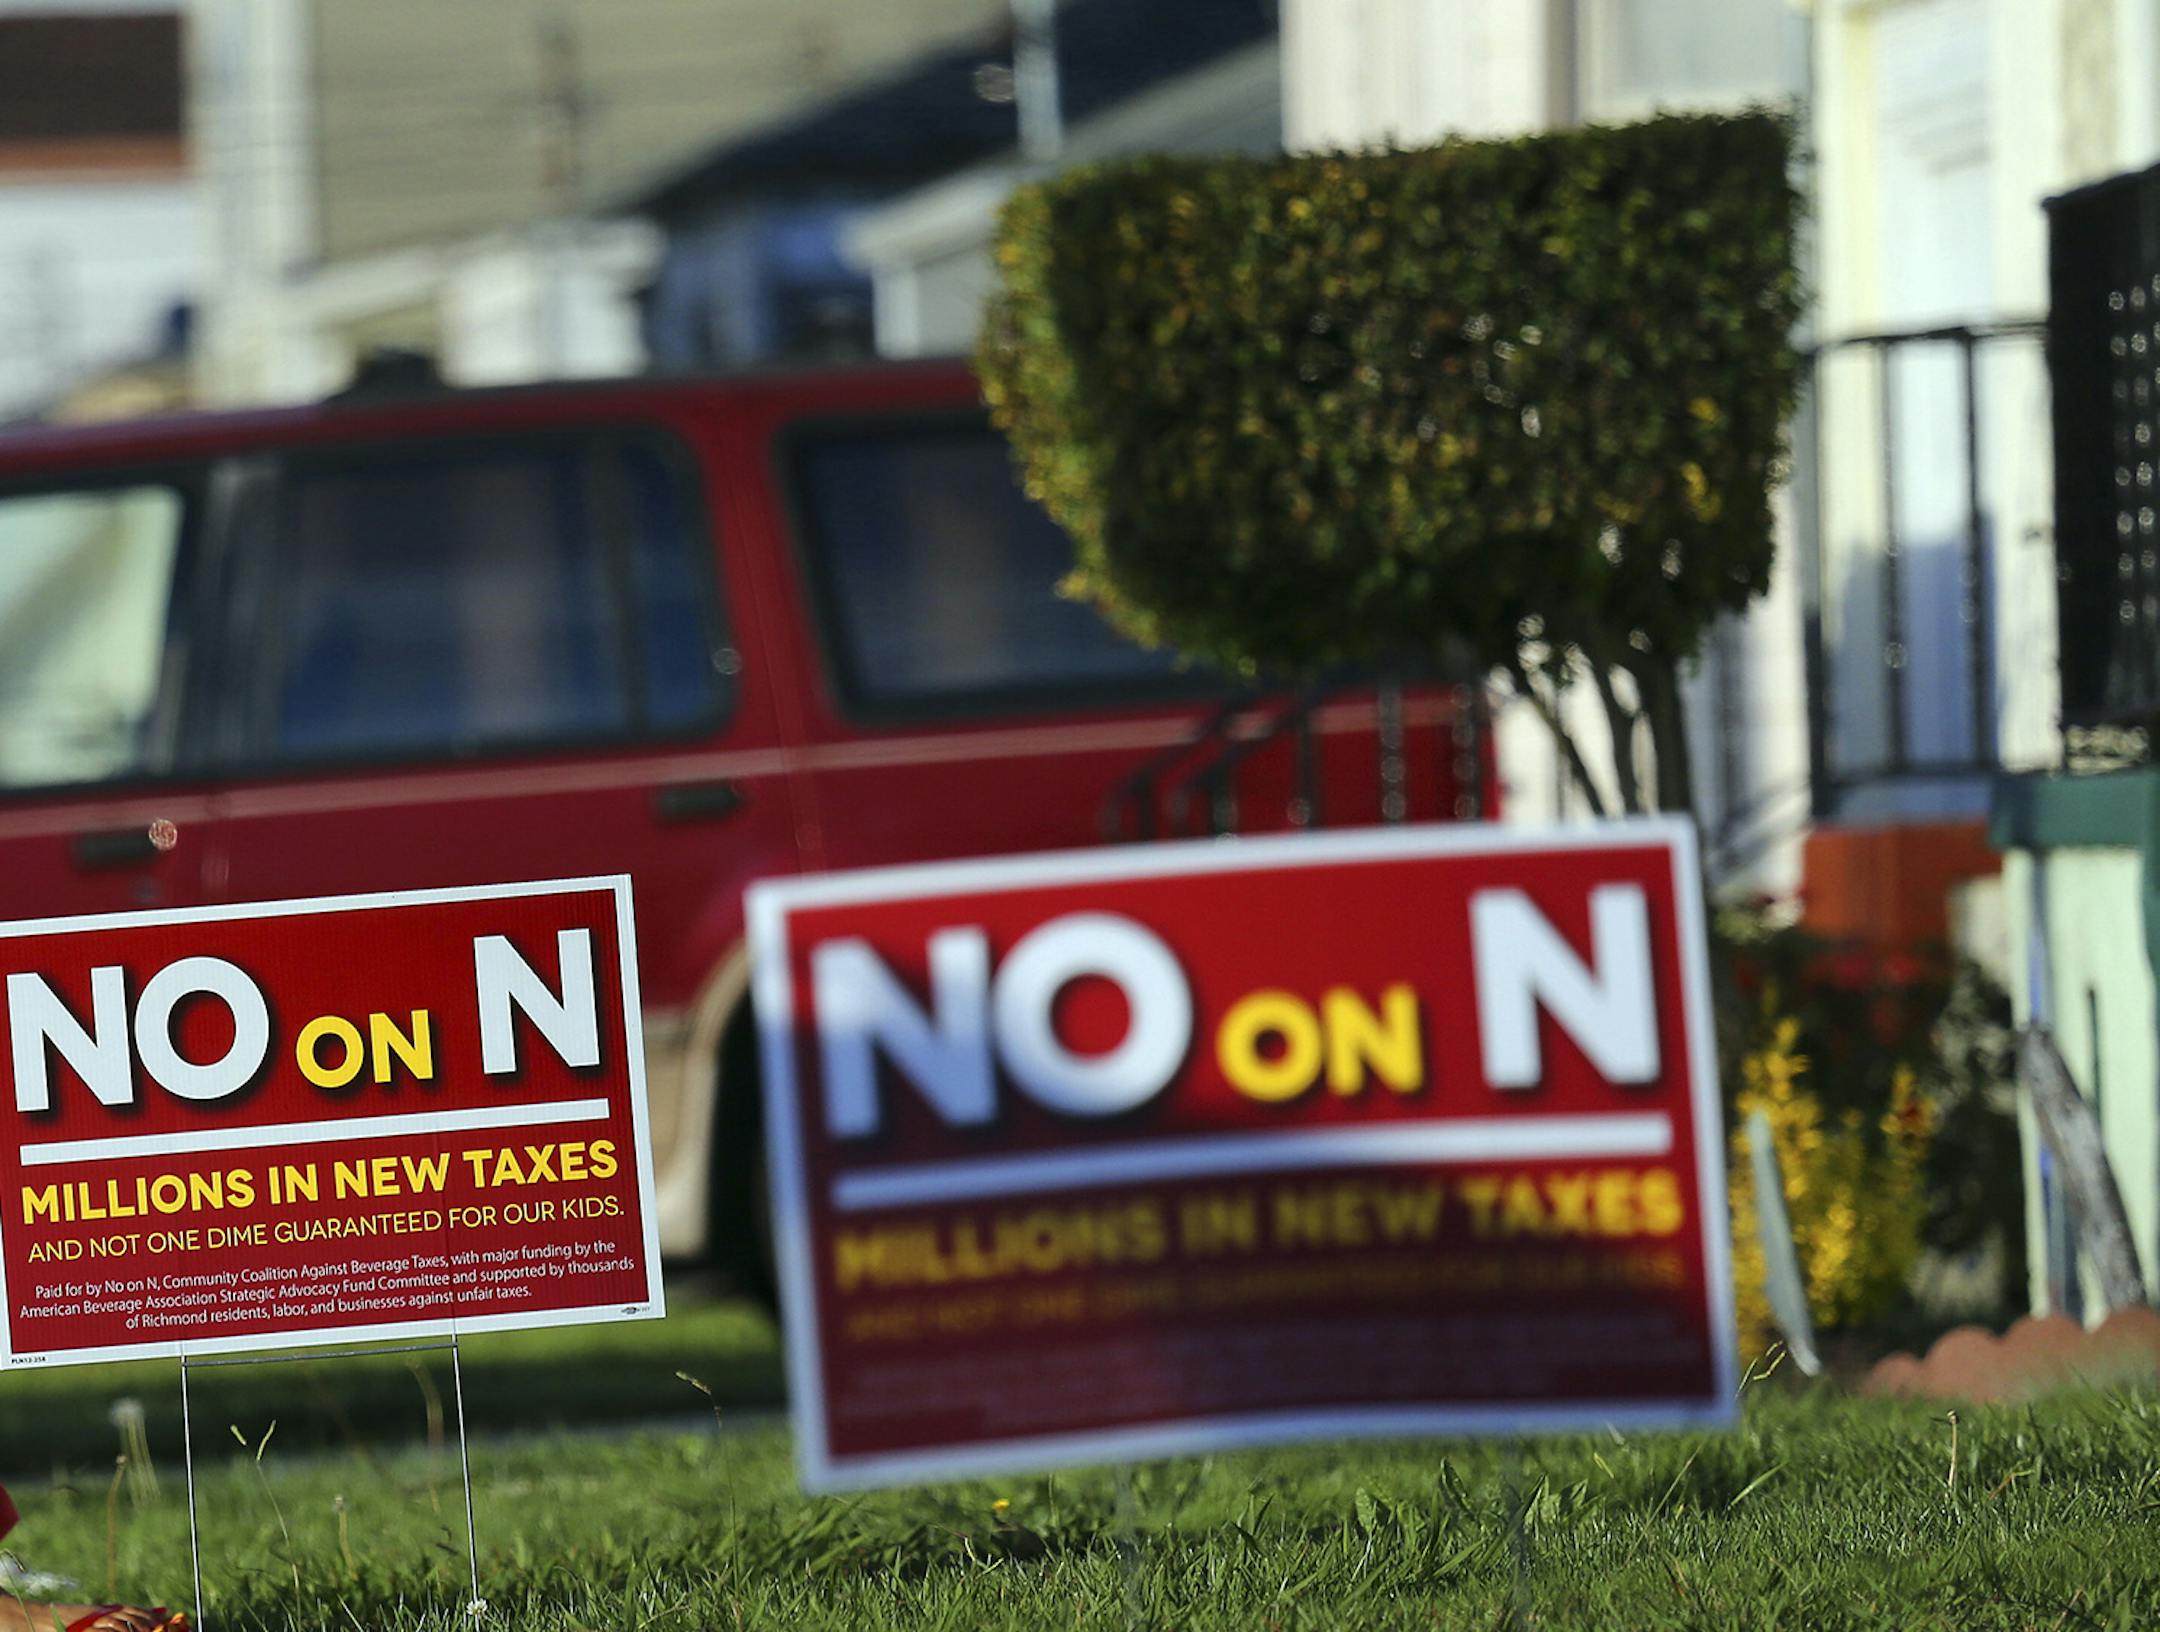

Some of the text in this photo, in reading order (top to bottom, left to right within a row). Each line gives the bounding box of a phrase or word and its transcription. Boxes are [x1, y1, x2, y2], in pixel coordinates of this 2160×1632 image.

[6, 927, 600, 1112] NO ON N
[810, 882, 1661, 1139] NO ON N
[21, 1139, 618, 1224] MILLIONS IN NEW TAXES
[28, 1194, 624, 1263] AND NOT ONE DIME GUARANTEED FOR OUR KIDS.
[835, 1169, 1684, 1290] MILLIONS IN NEW TAXES
[19, 1256, 634, 1318] American Beverage Association Strategic Advocacy Fund Committee and supported by thousands
[35, 1239, 615, 1299] Paid for by No on N, Community Coalition Against Beverage Taxes, with major funding by the
[125, 1285, 532, 1329] of Richmond residents, labor, and businesses against unfair taxes.
